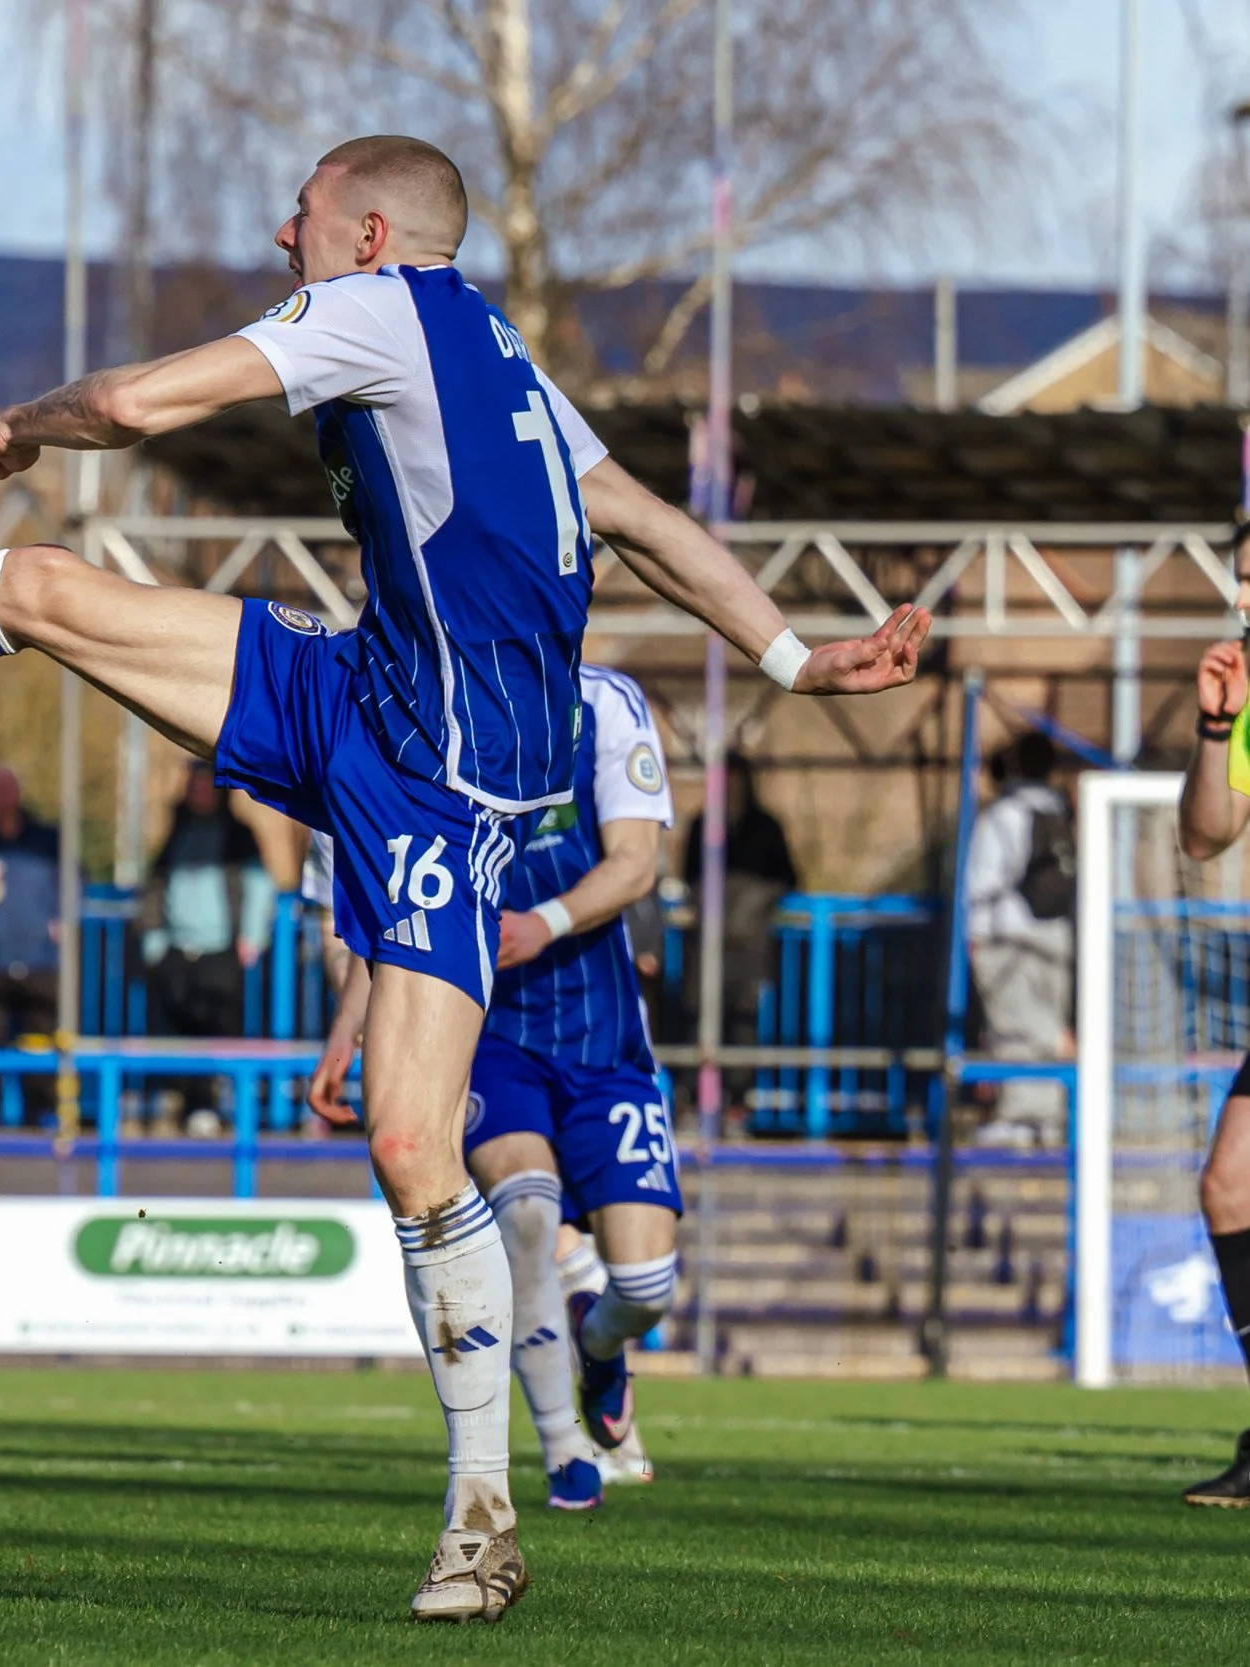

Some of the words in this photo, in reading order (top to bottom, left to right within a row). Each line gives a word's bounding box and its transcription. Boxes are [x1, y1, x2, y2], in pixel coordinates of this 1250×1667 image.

[511, 390, 580, 576] 1
[387, 834, 454, 910] 16
[608, 1101, 671, 1165] 25
[110, 1221, 321, 1276] Pinnacle
